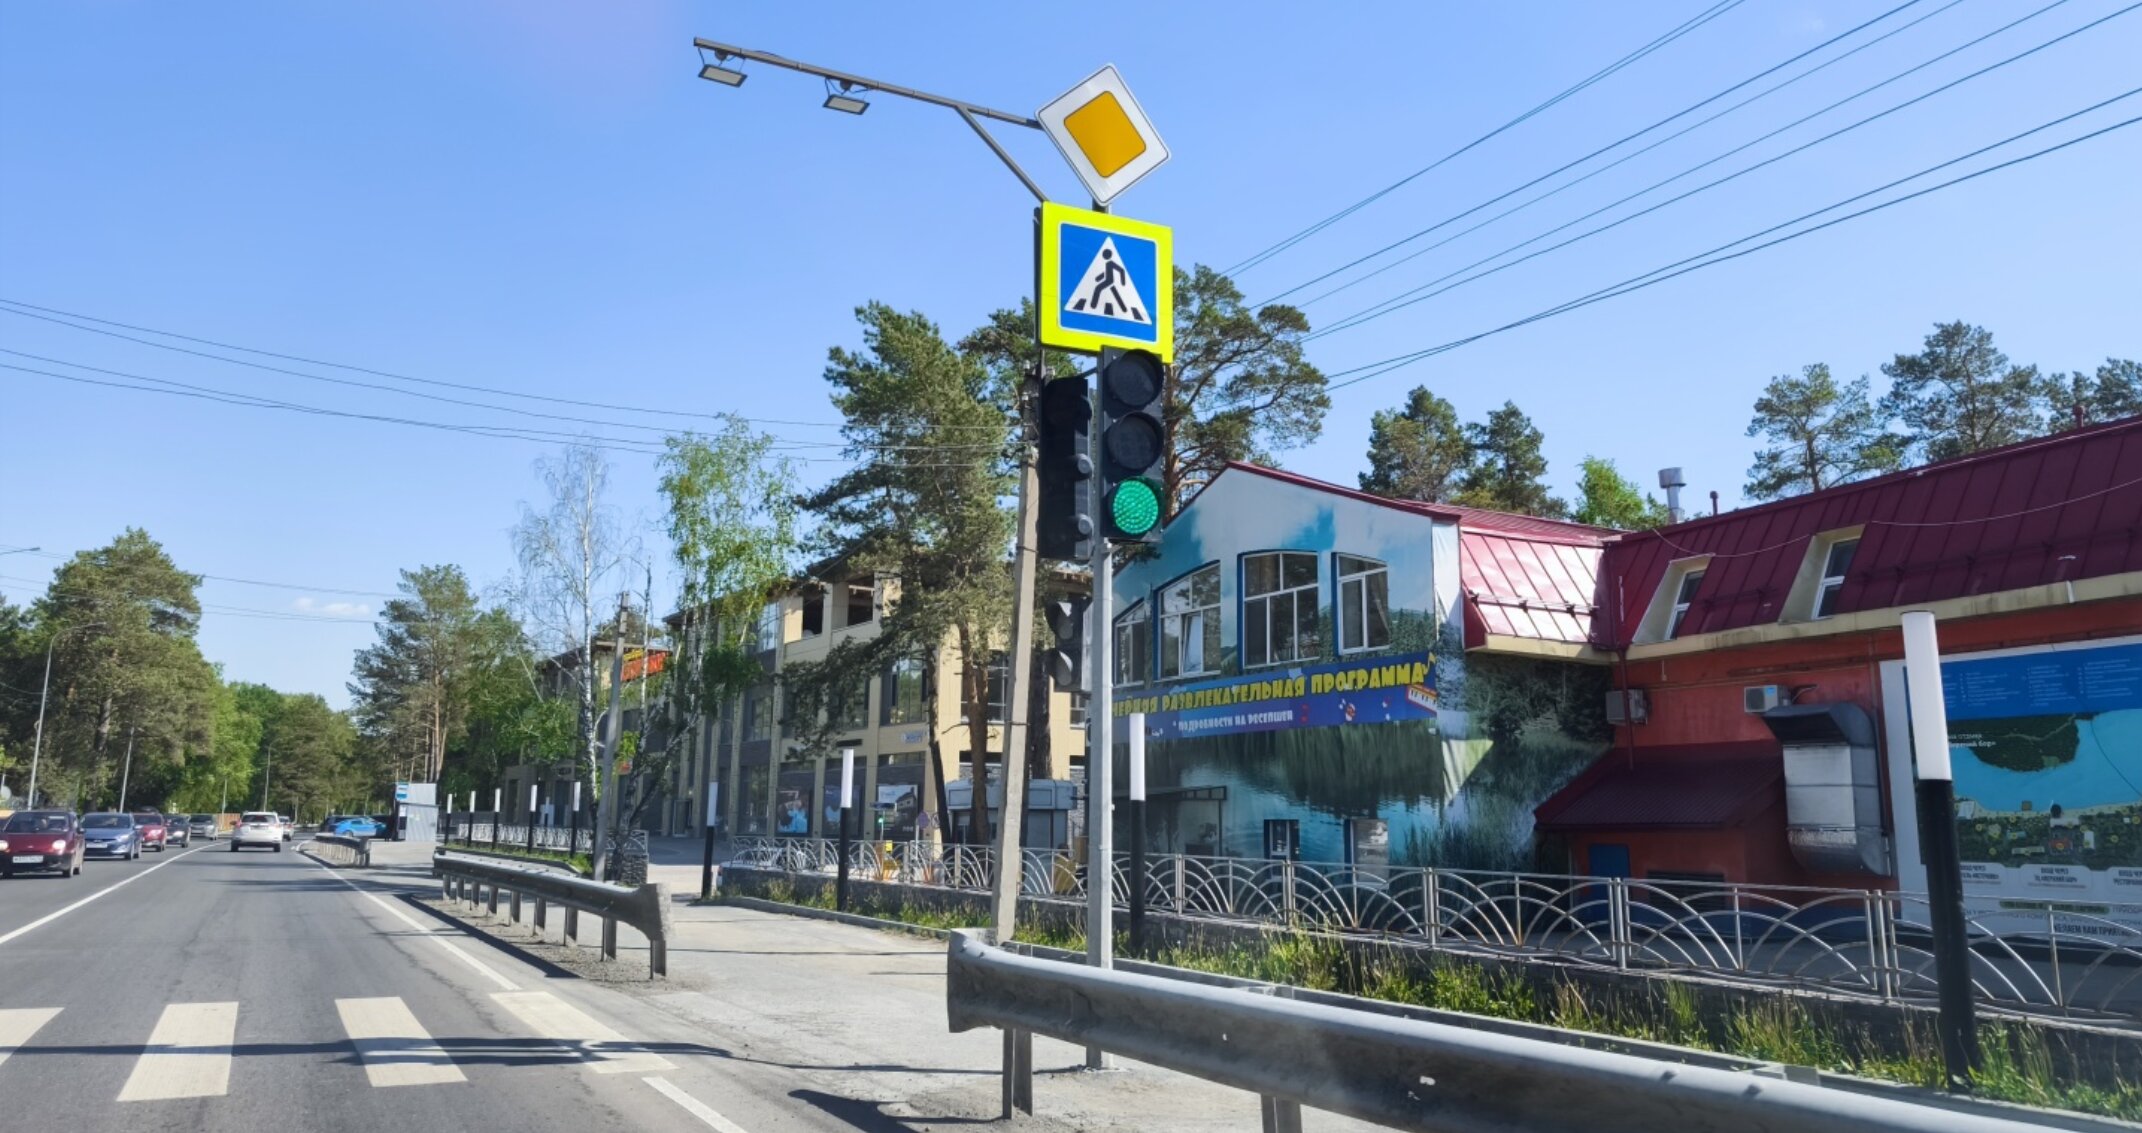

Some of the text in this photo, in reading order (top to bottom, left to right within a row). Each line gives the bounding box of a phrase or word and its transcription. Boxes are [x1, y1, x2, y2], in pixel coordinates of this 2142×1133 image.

[1112, 662, 1425, 717] ЧЕРНЯЯ РАЗВЛЕКАТЕЛЬНАЯ ПРОГРАММА
[1178, 716, 1233, 732] ПОДРОБНОСТИ
[1235, 714, 1246, 726] НА
